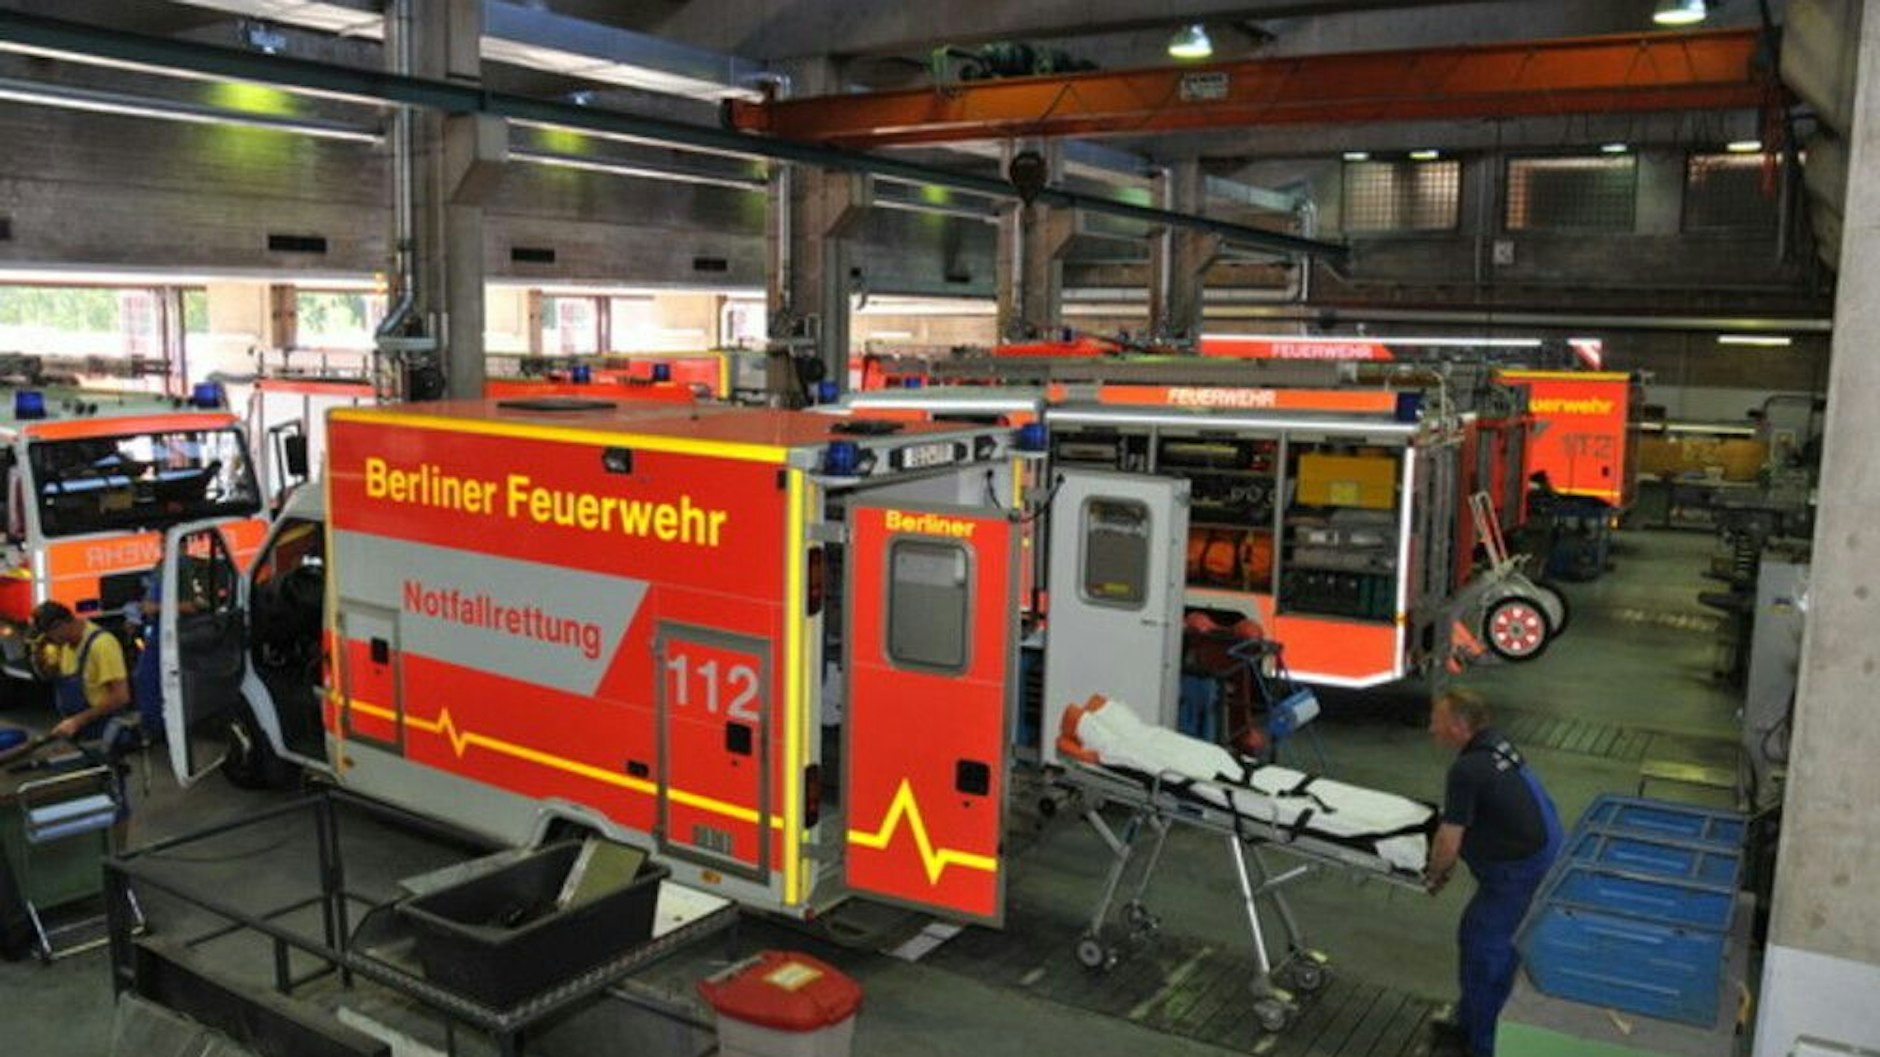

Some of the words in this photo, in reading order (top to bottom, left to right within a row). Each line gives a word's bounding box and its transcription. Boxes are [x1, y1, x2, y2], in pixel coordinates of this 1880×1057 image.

[1271, 343, 1374, 360] FEUERWEHR
[1167, 387, 1277, 407] FEUERWEHR
[365, 457, 497, 514] Berliner
[507, 475, 727, 546] Feuerwehr
[886, 509, 975, 538] Berliner
[404, 580, 602, 660] Notfallrettung
[665, 650, 761, 722] 112
